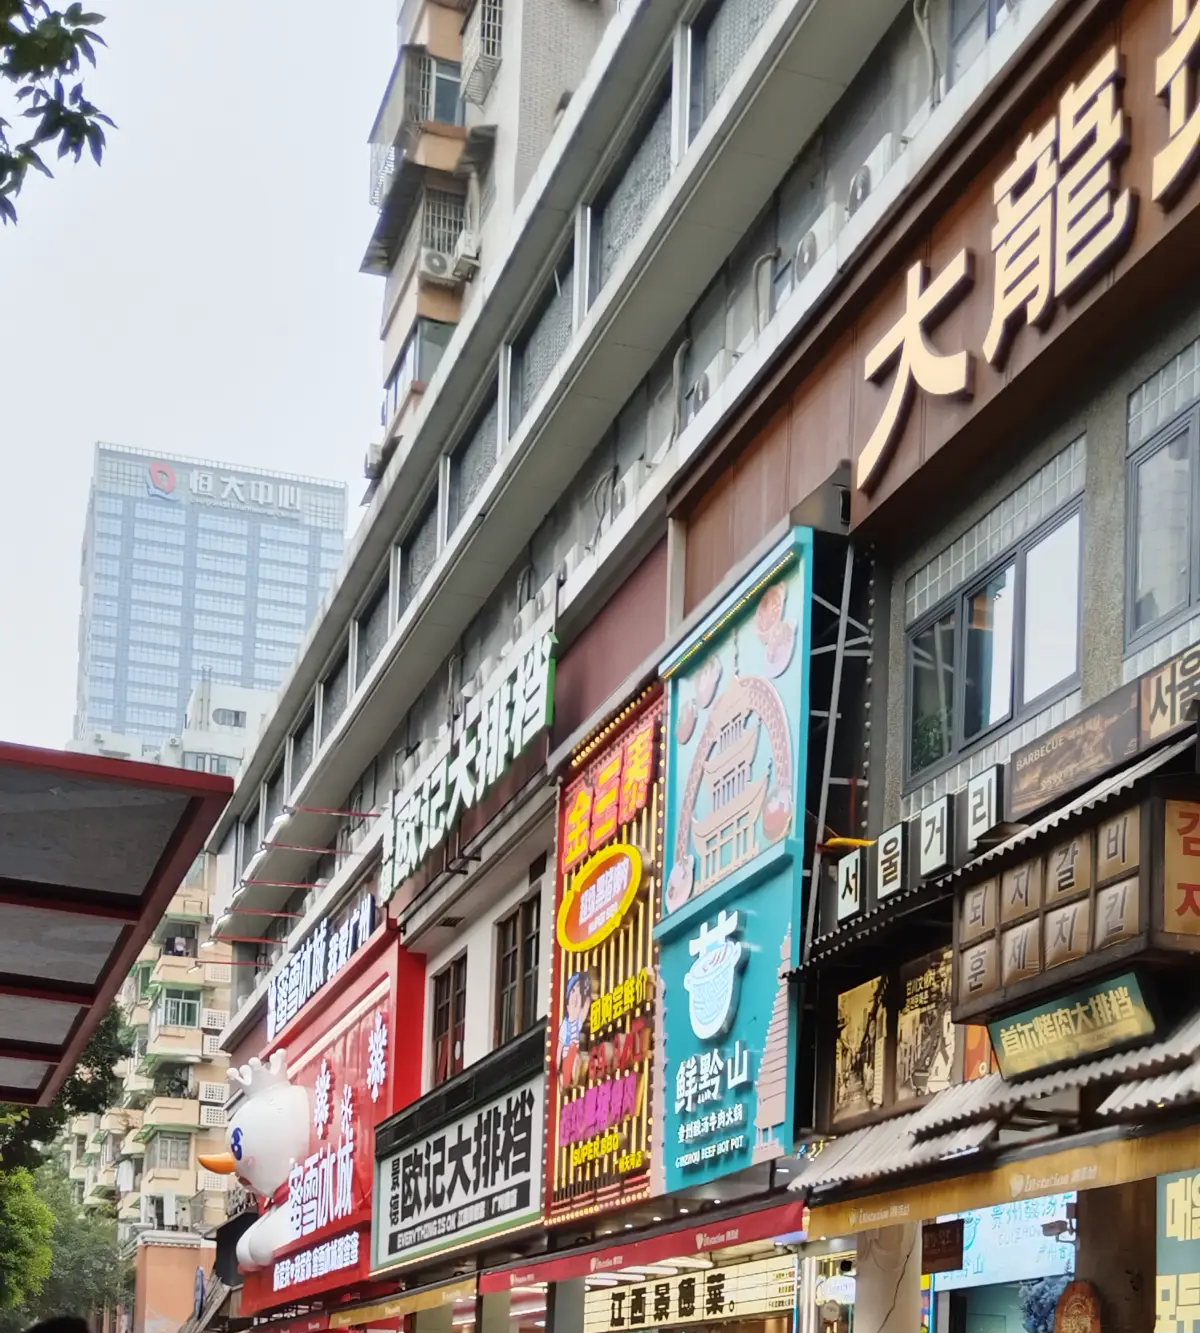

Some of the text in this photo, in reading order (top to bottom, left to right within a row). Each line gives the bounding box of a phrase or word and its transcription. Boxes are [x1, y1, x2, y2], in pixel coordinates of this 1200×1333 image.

[190, 468, 301, 512] 恒大中心
[393, 632, 552, 885] 欧记大排档
[1015, 736, 1065, 771] BARBECUE
[841, 777, 993, 903] 서울거리
[968, 885, 1128, 993] 훈제치킨
[1000, 986, 1136, 1057] 首尔烤肉大排档
[675, 1040, 748, 1115] 鲜黔山
[289, 1136, 355, 1238] 蜜雪冰城
[401, 1089, 535, 1223] 欧记大排档
